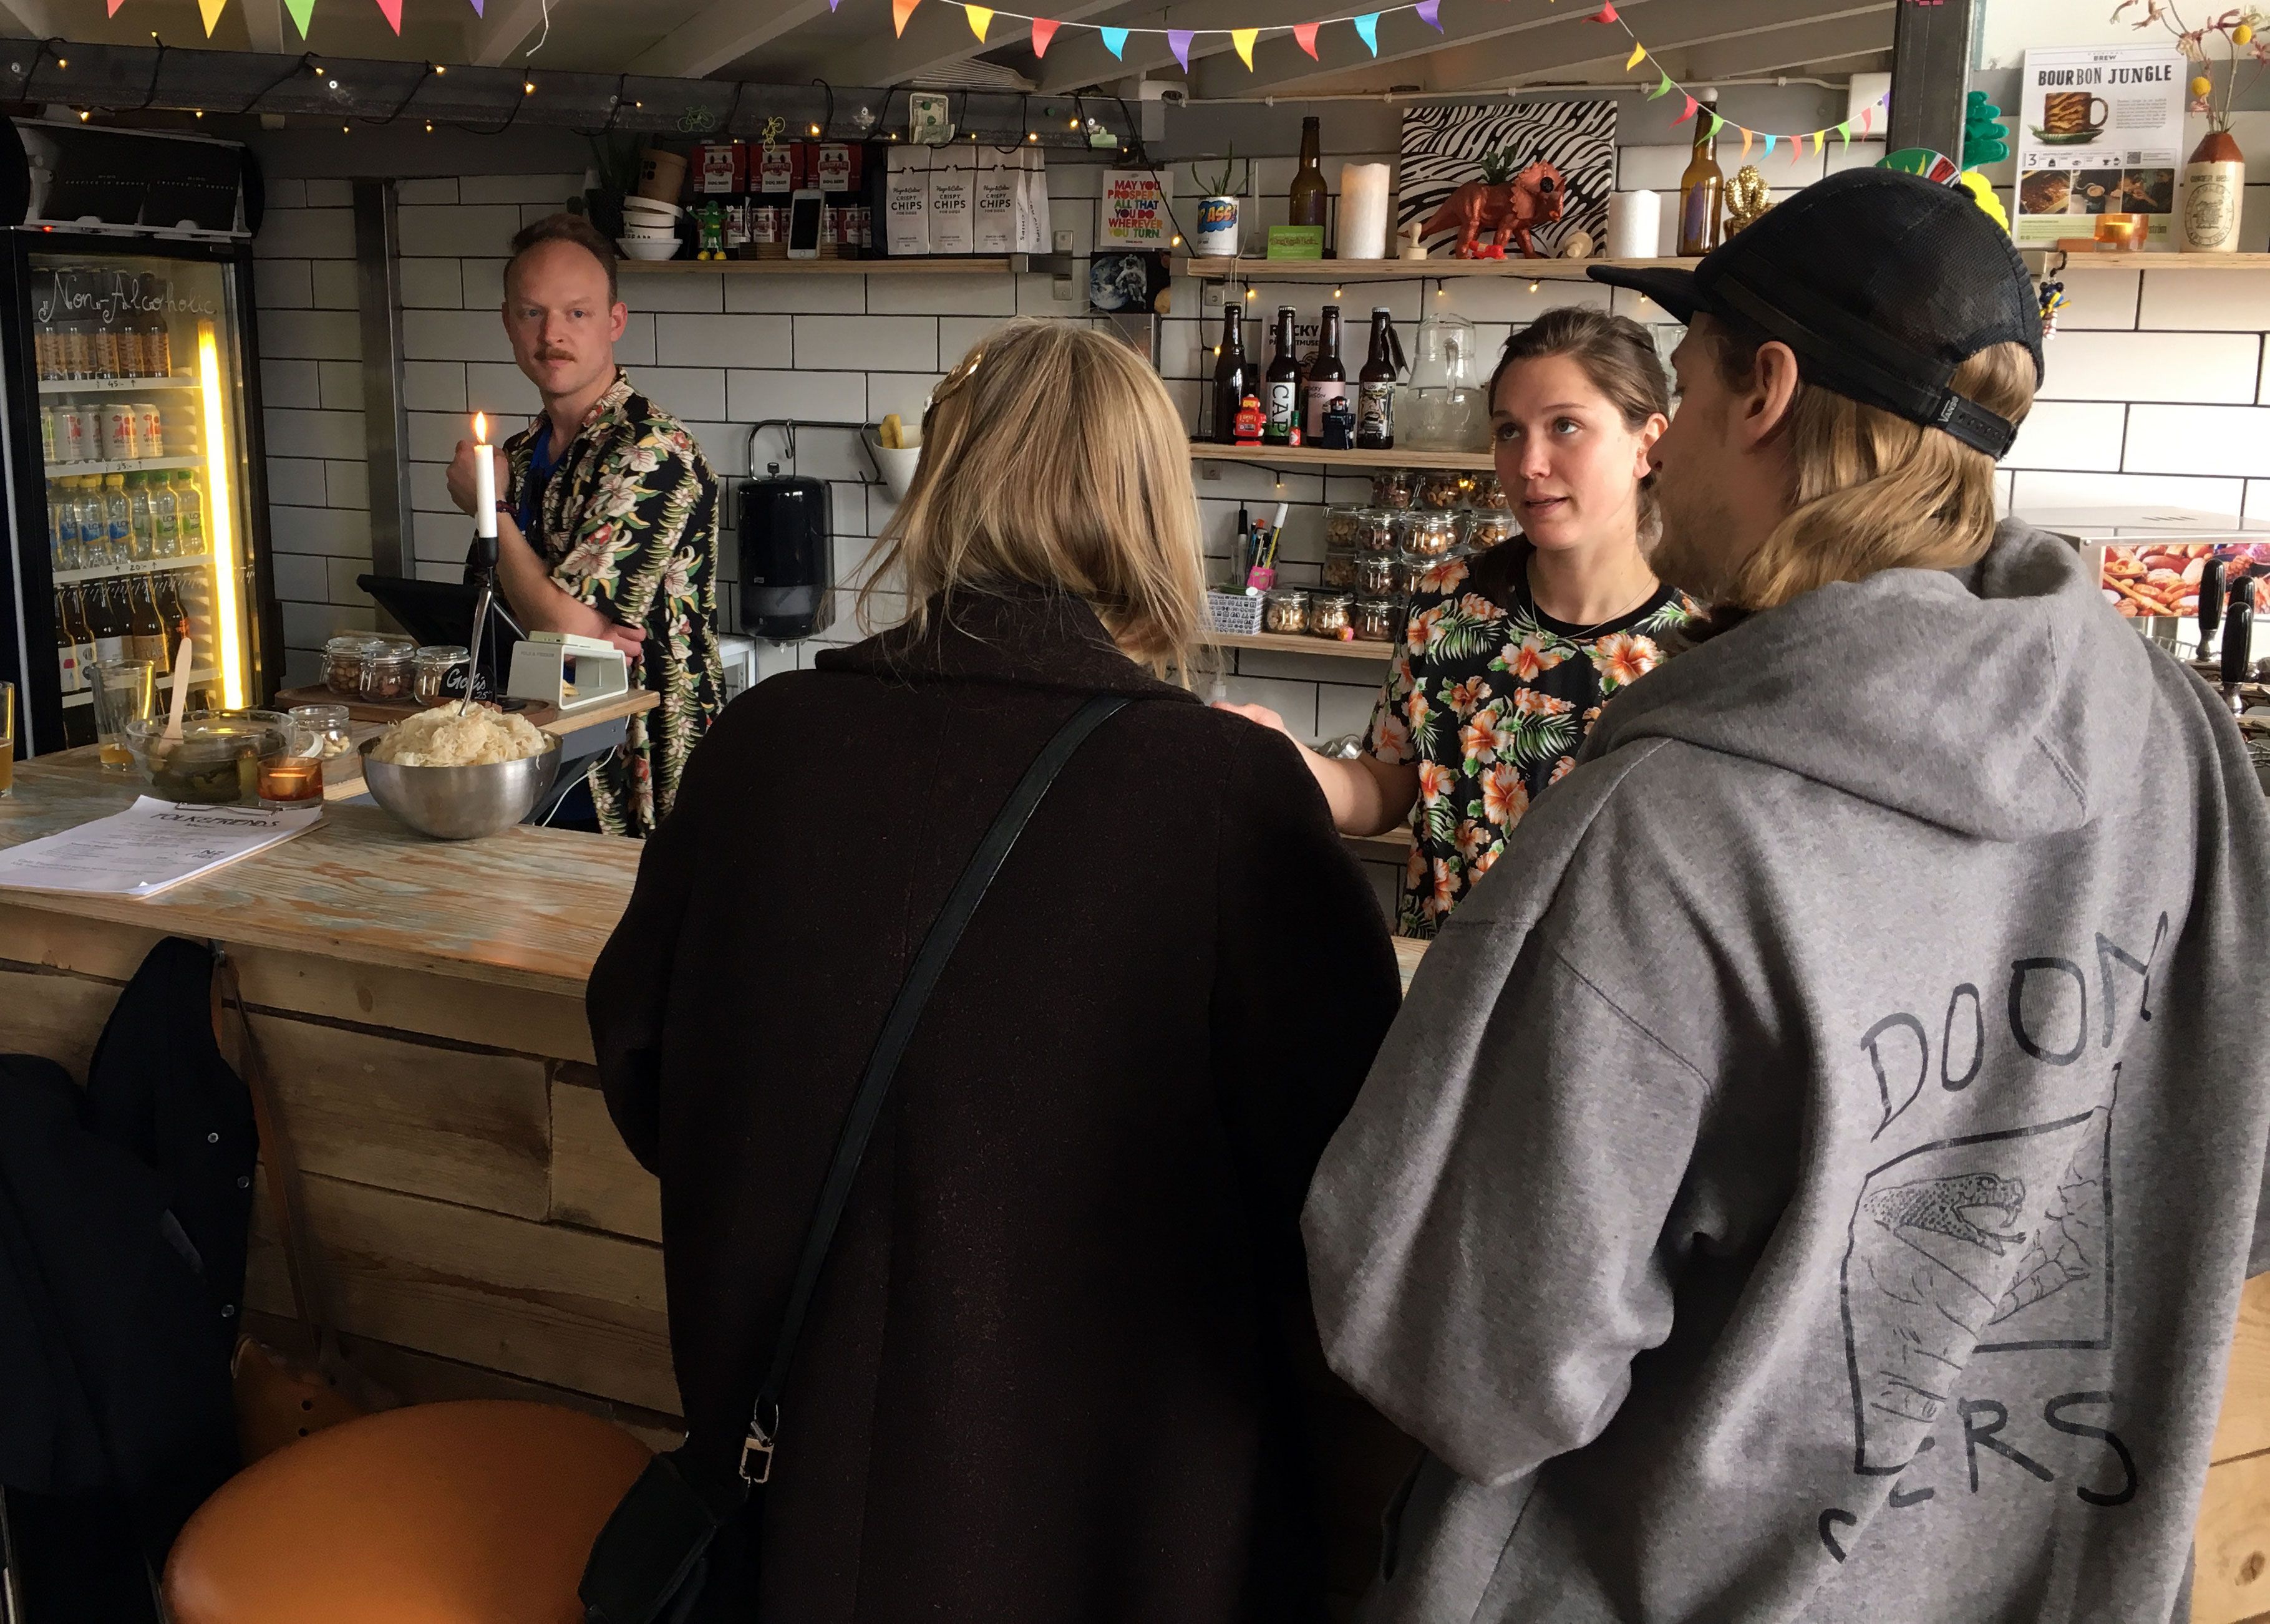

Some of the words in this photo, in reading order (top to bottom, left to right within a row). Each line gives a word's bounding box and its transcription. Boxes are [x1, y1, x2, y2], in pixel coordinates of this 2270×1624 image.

[2038, 67, 2102, 86] BOURBON
[2108, 64, 2172, 84] JUNGLE
[2028, 153, 2037, 166] 3
[1115, 180, 1137, 190] MAY
[1140, 181, 1160, 190] YOU
[1107, 190, 1154, 200] PROSPER
[891, 201, 922, 211] CHIPS
[934, 200, 966, 209] CHIPS
[979, 199, 1011, 208] CHIPS
[1114, 200, 1132, 209] ALL
[1135, 200, 1160, 210] THAT
[1115, 209, 1136, 219] YOU
[1108, 218, 1163, 229] WHEREVER
[1108, 228, 1129, 237] YOU
[1133, 228, 1161, 238] TURN.
[38, 271, 216, 323] Non-Alcoholic
[1269, 324, 1319, 337] RCKY
[1273, 385, 1289, 433] CAP
